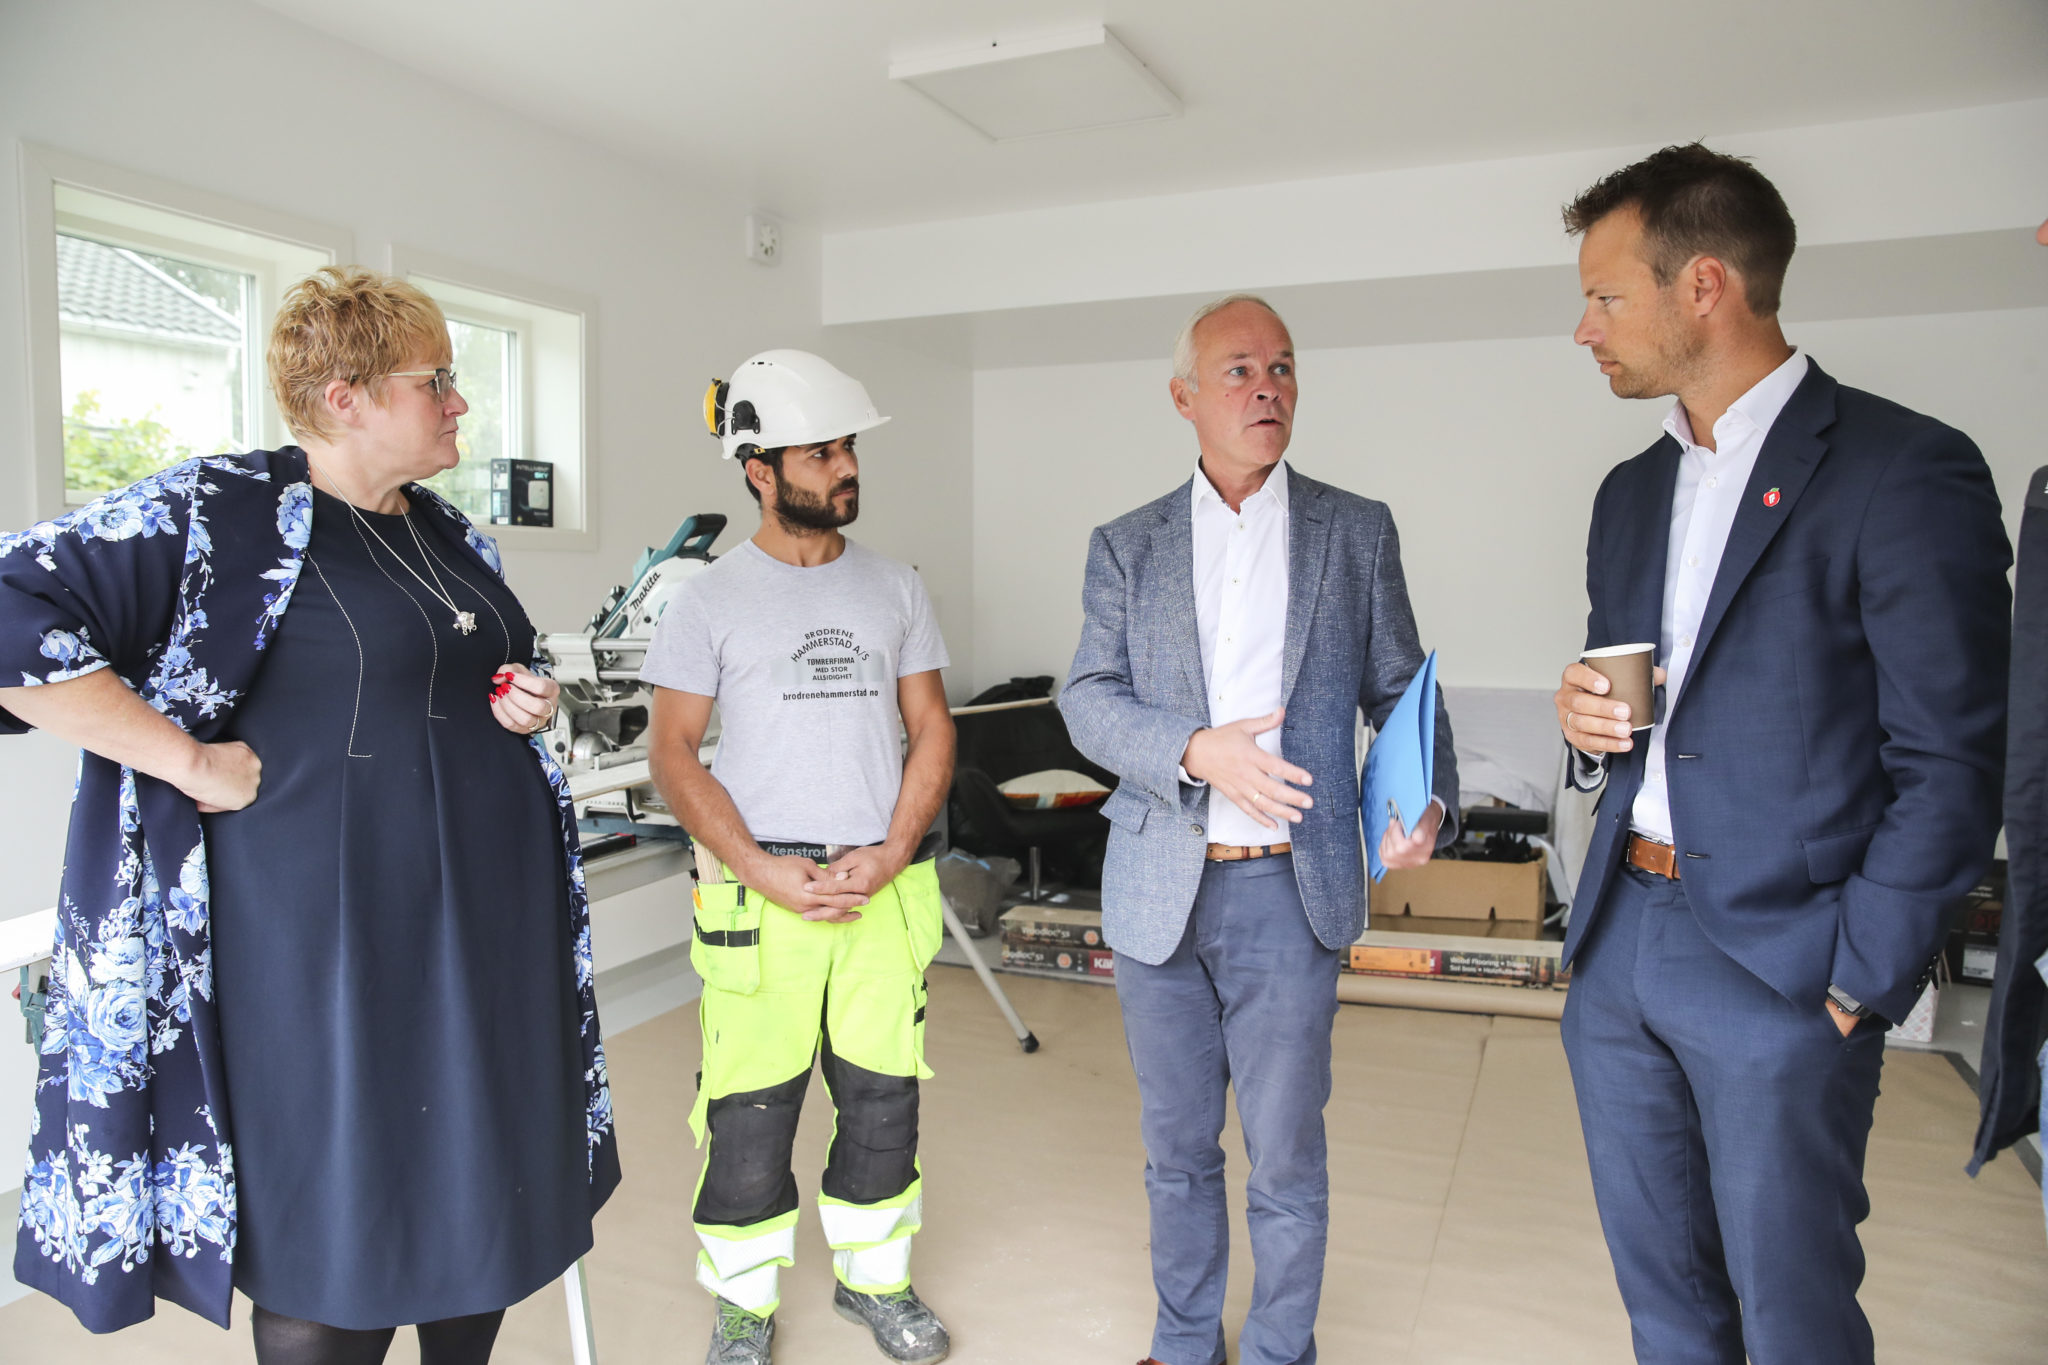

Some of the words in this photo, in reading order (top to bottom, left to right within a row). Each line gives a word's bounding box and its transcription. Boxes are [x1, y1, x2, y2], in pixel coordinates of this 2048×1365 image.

[804, 628, 855, 640] BRØDRENE
[790, 637, 852, 662] HAMMERSTAD
[853, 645, 870, 661] A/S
[807, 657, 855, 665] TØMRERFIRMA
[812, 673, 852, 681] ALLSIDIGHET
